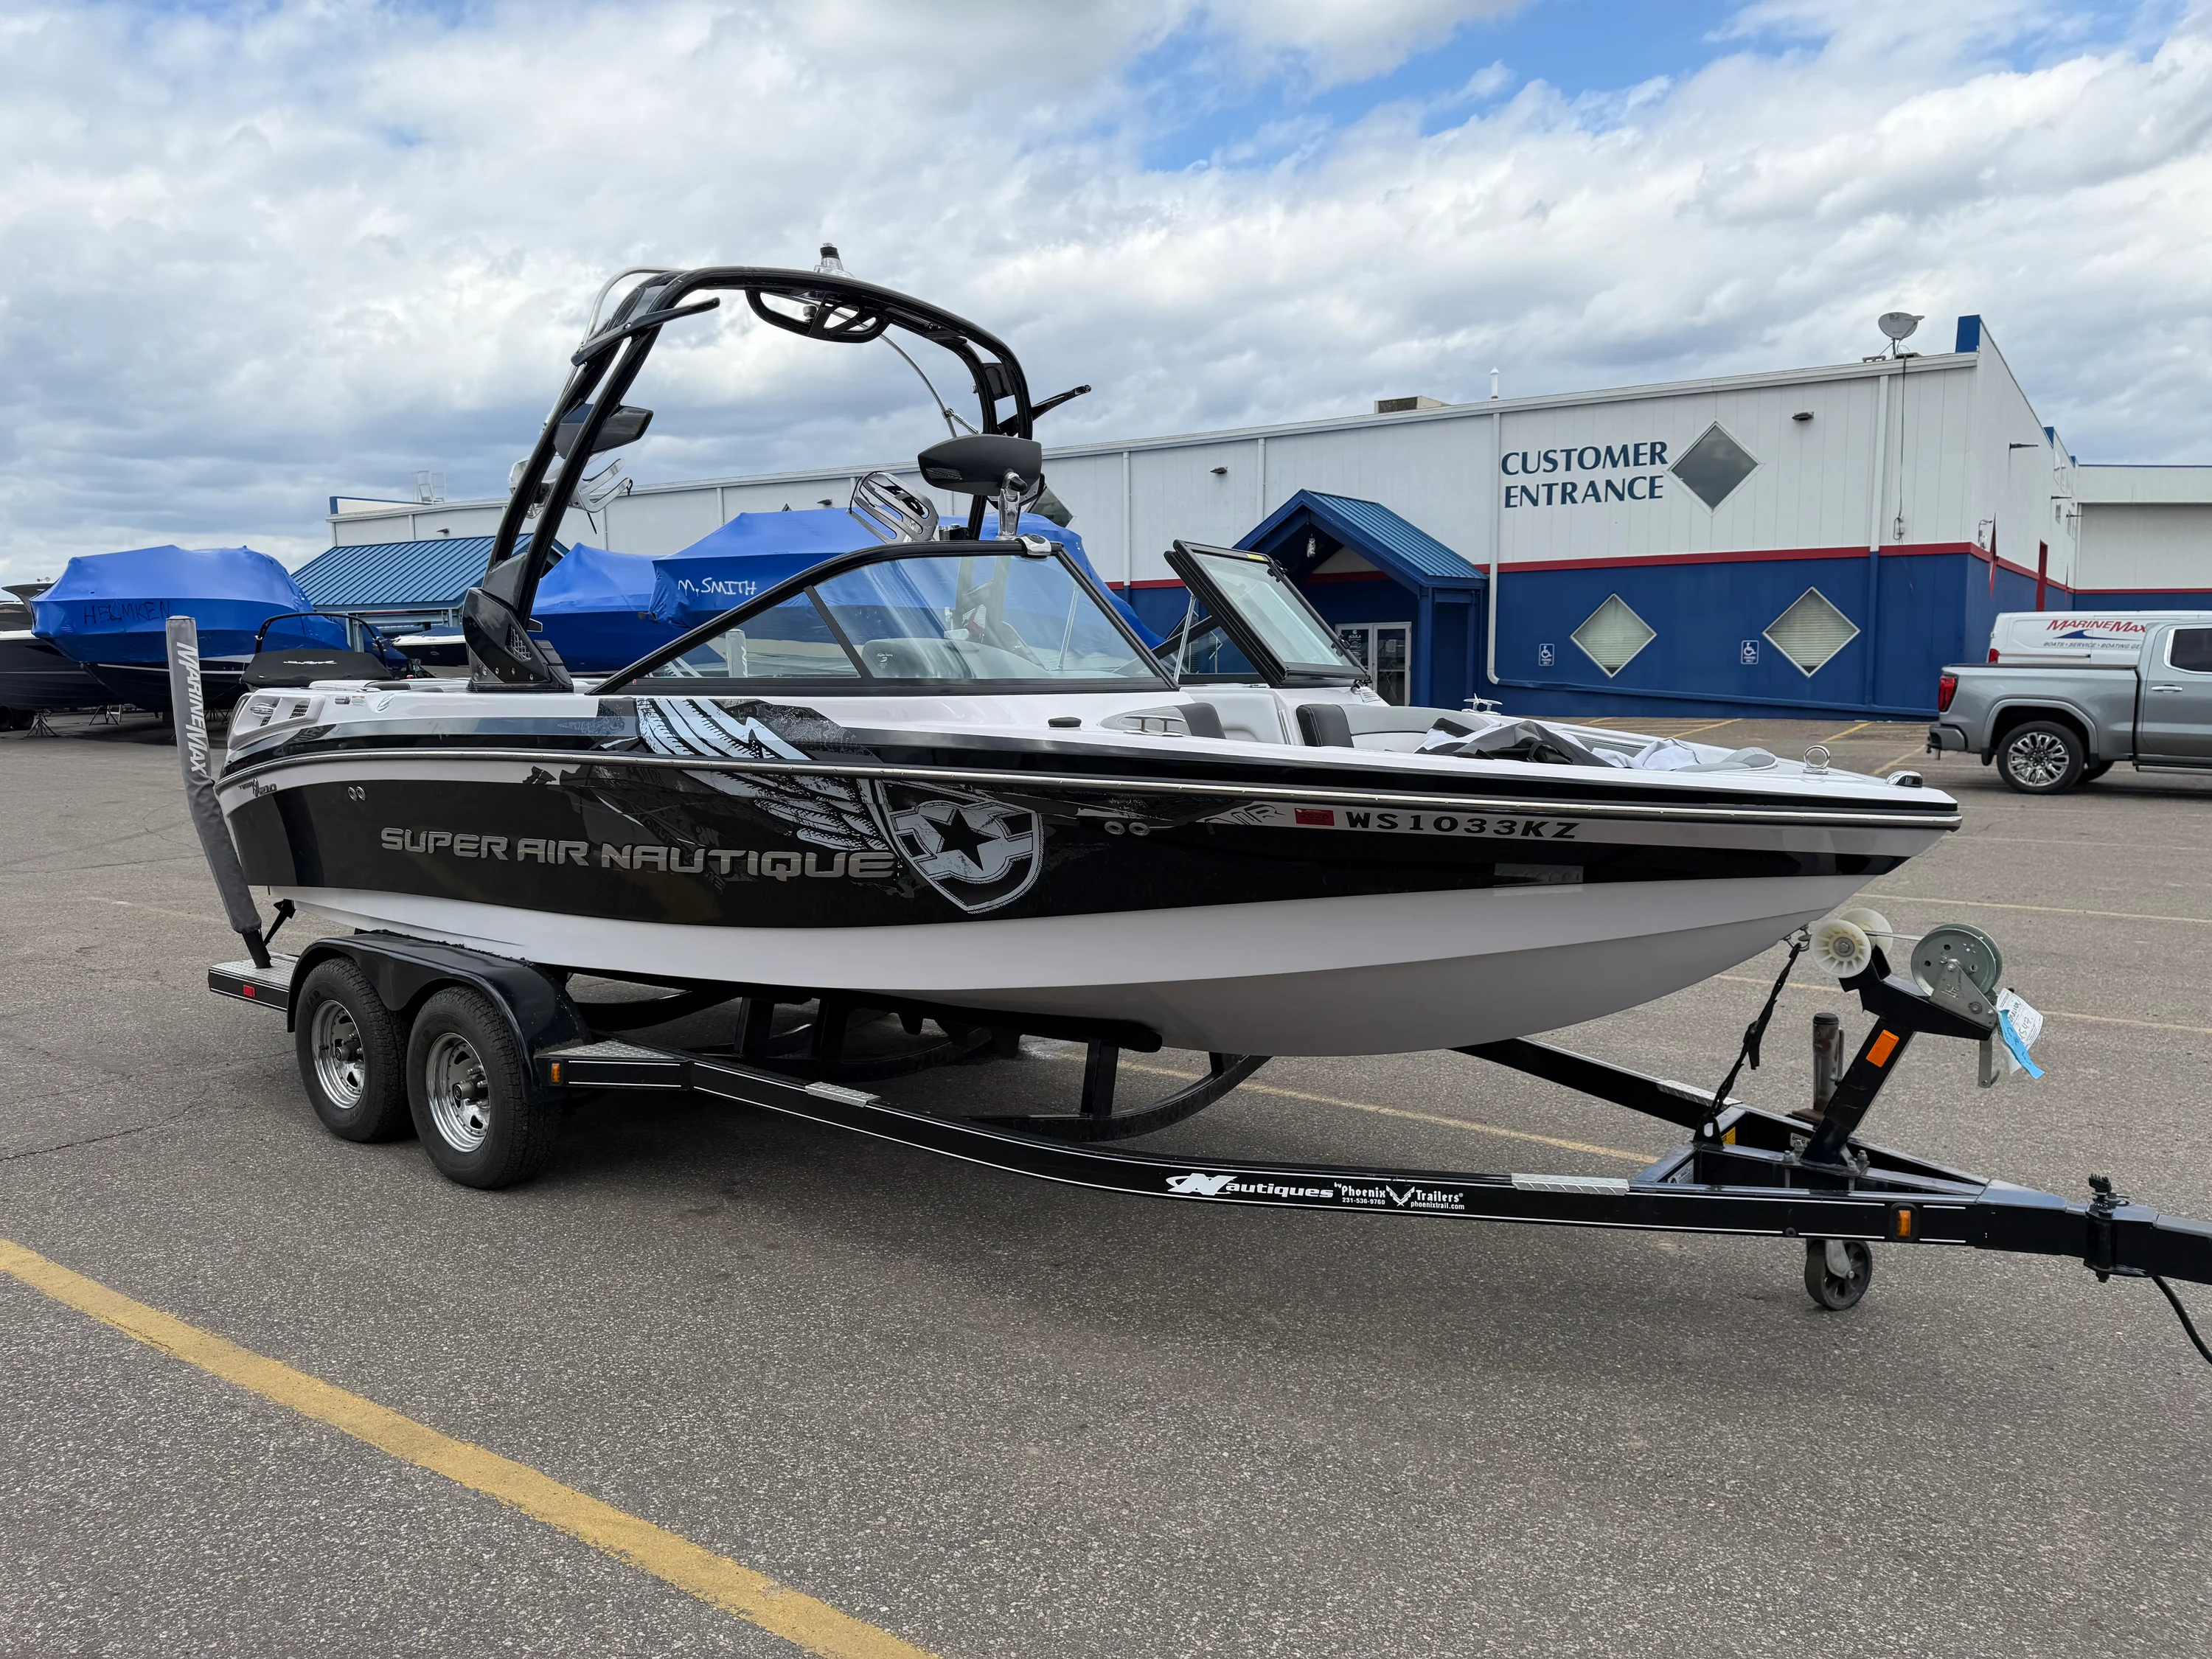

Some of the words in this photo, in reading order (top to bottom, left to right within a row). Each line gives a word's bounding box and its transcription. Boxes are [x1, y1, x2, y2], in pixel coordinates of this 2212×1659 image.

[1501, 441, 1669, 476] CUSTOMER
[1504, 475, 1663, 509] ENTRANCE
[84, 600, 170, 625] HELMKEN
[1346, 811, 1580, 839] WS1033KZ
[380, 827, 509, 861] SUPER
[517, 837, 590, 866] AIR
[601, 843, 895, 882] NAUTIQUE
[1342, 1185, 1386, 1198] Phoenix
[1411, 1200, 1465, 1210] phoenixtrail.com
